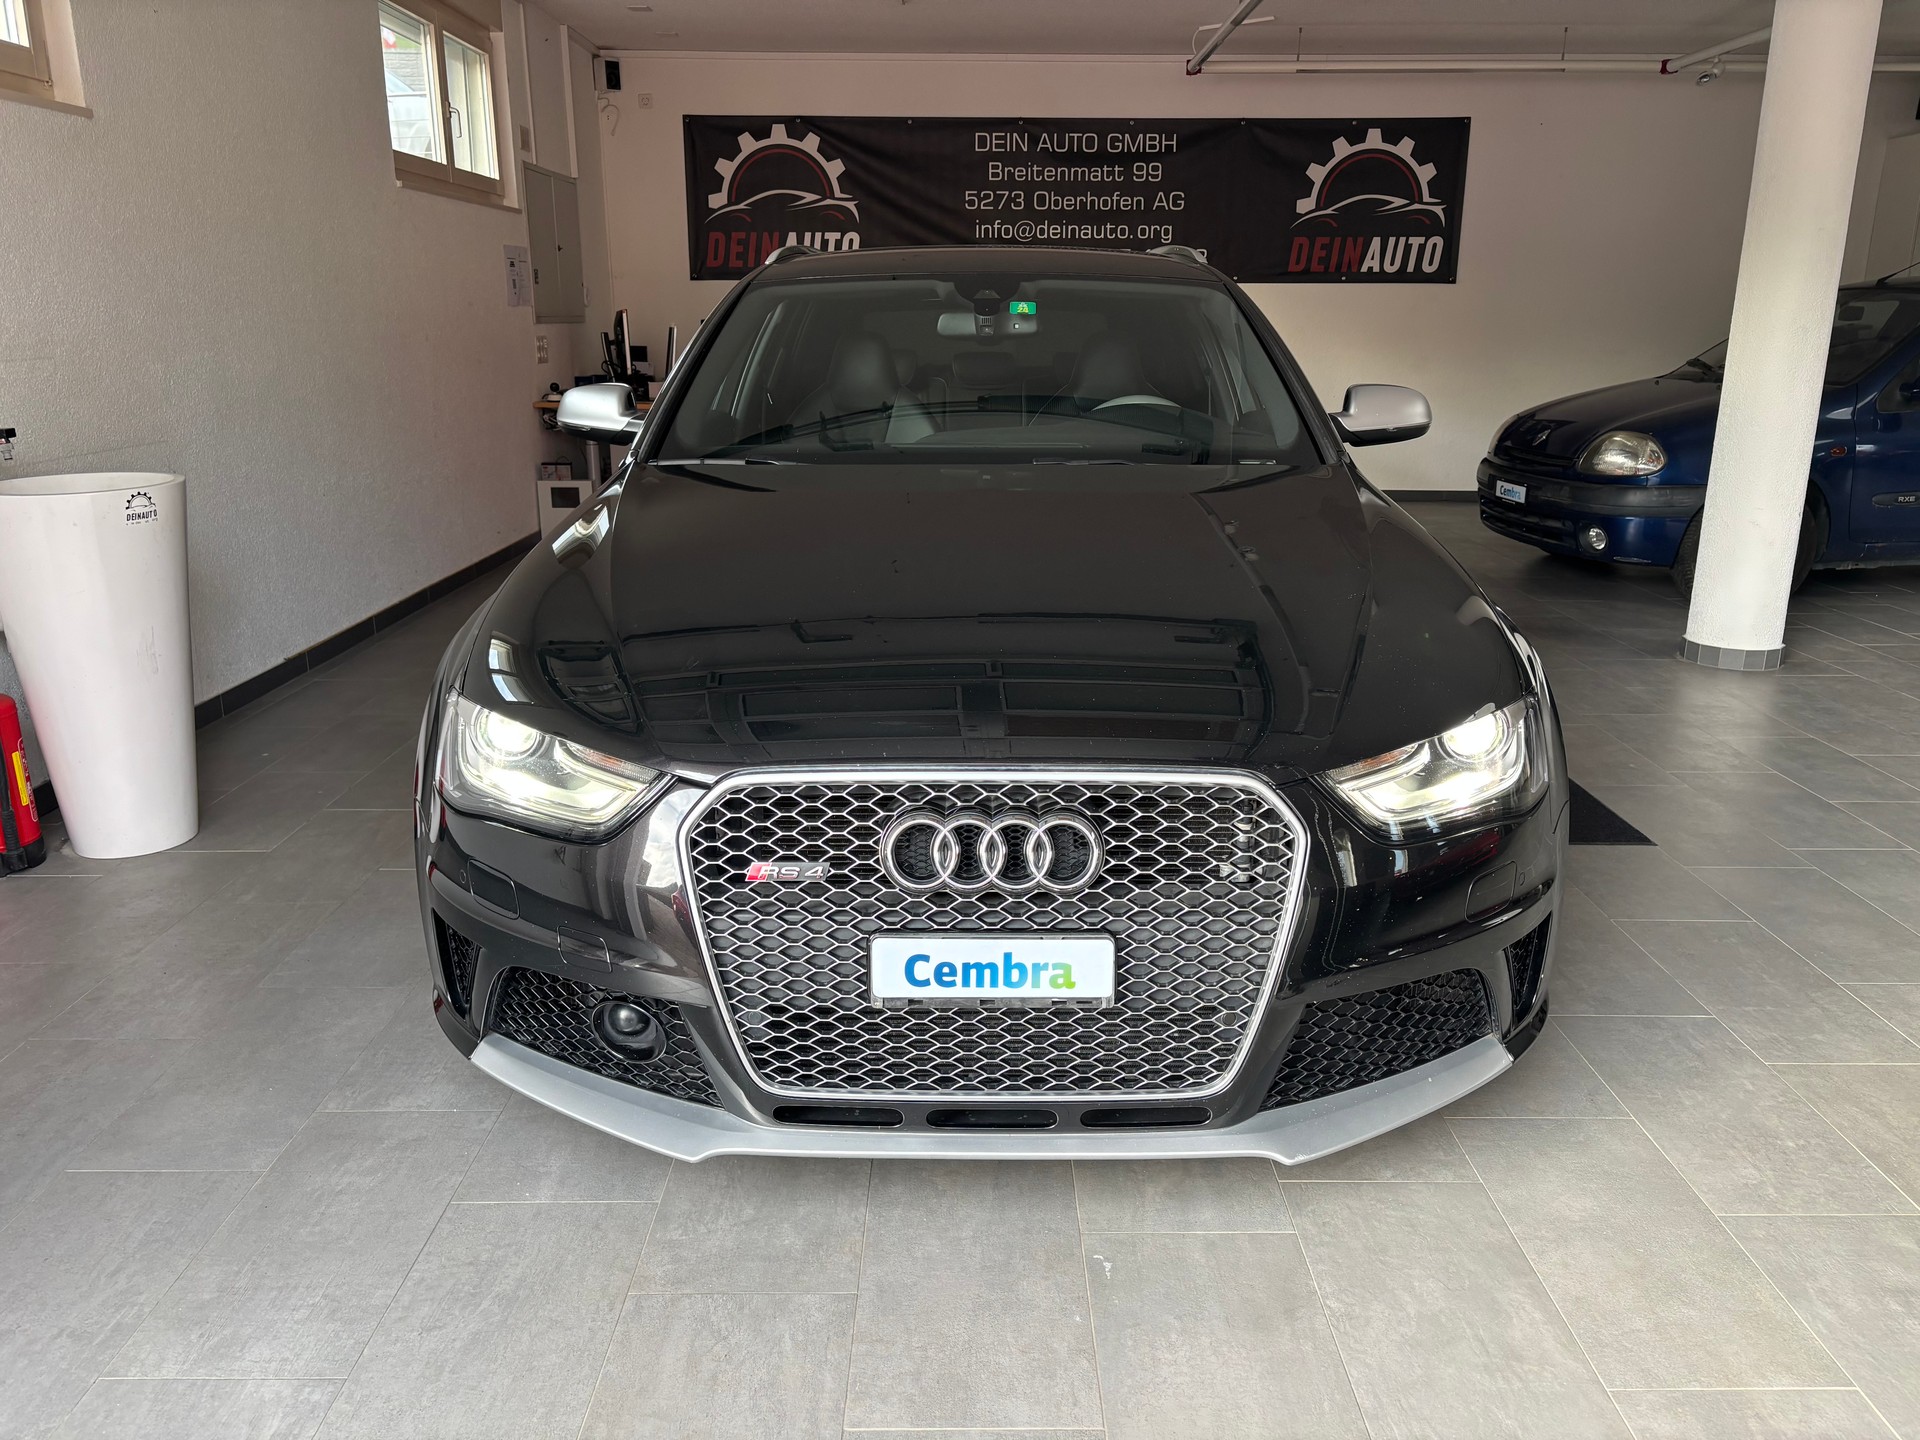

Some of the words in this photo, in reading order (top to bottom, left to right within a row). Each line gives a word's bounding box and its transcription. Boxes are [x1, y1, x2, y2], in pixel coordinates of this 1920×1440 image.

[975, 132, 1028, 152] DEIN
[1036, 133, 1098, 153] AUTO
[1107, 133, 1177, 153] GMBH
[988, 161, 1124, 182] Breitenmatt
[1132, 162, 1162, 182] 99
[964, 190, 1025, 210] 5273
[1033, 190, 1145, 211] Oberhofen
[1152, 191, 1185, 211] AG
[975, 219, 1173, 244] info@deinauto.org
[1287, 235, 1444, 273] DEINAUTO
[1500, 484, 1521, 500] Cembra
[1897, 495, 1916, 503] RXE
[126, 509, 158, 522] DEINAUTO
[904, 951, 1076, 989] Cembra
